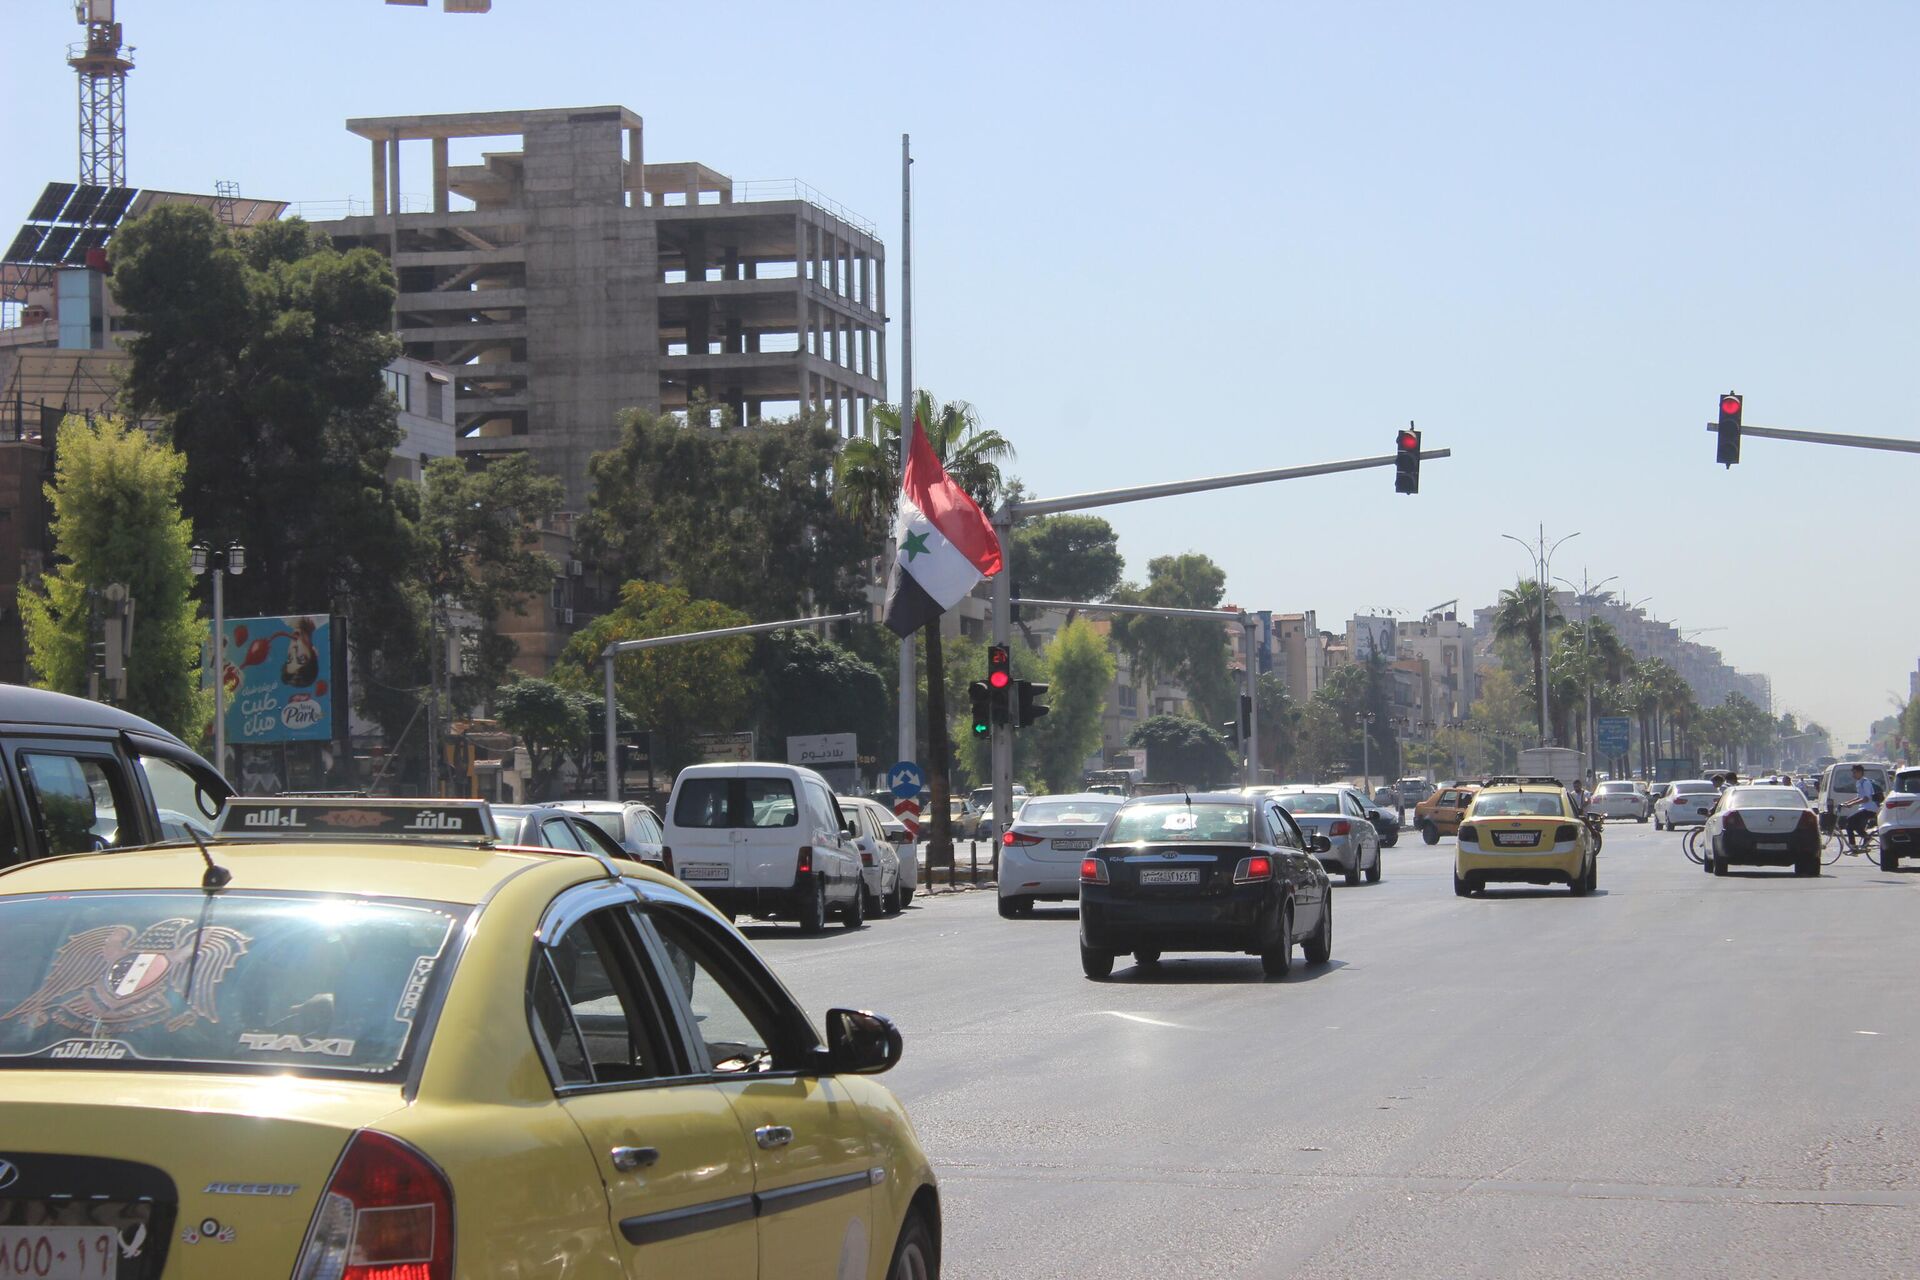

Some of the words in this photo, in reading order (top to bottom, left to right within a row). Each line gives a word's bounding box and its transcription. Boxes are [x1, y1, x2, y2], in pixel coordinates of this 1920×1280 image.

[284, 707, 316, 723] Park
[402, 959, 434, 1017] HYUNDAI
[238, 1033, 356, 1057] TAXI
